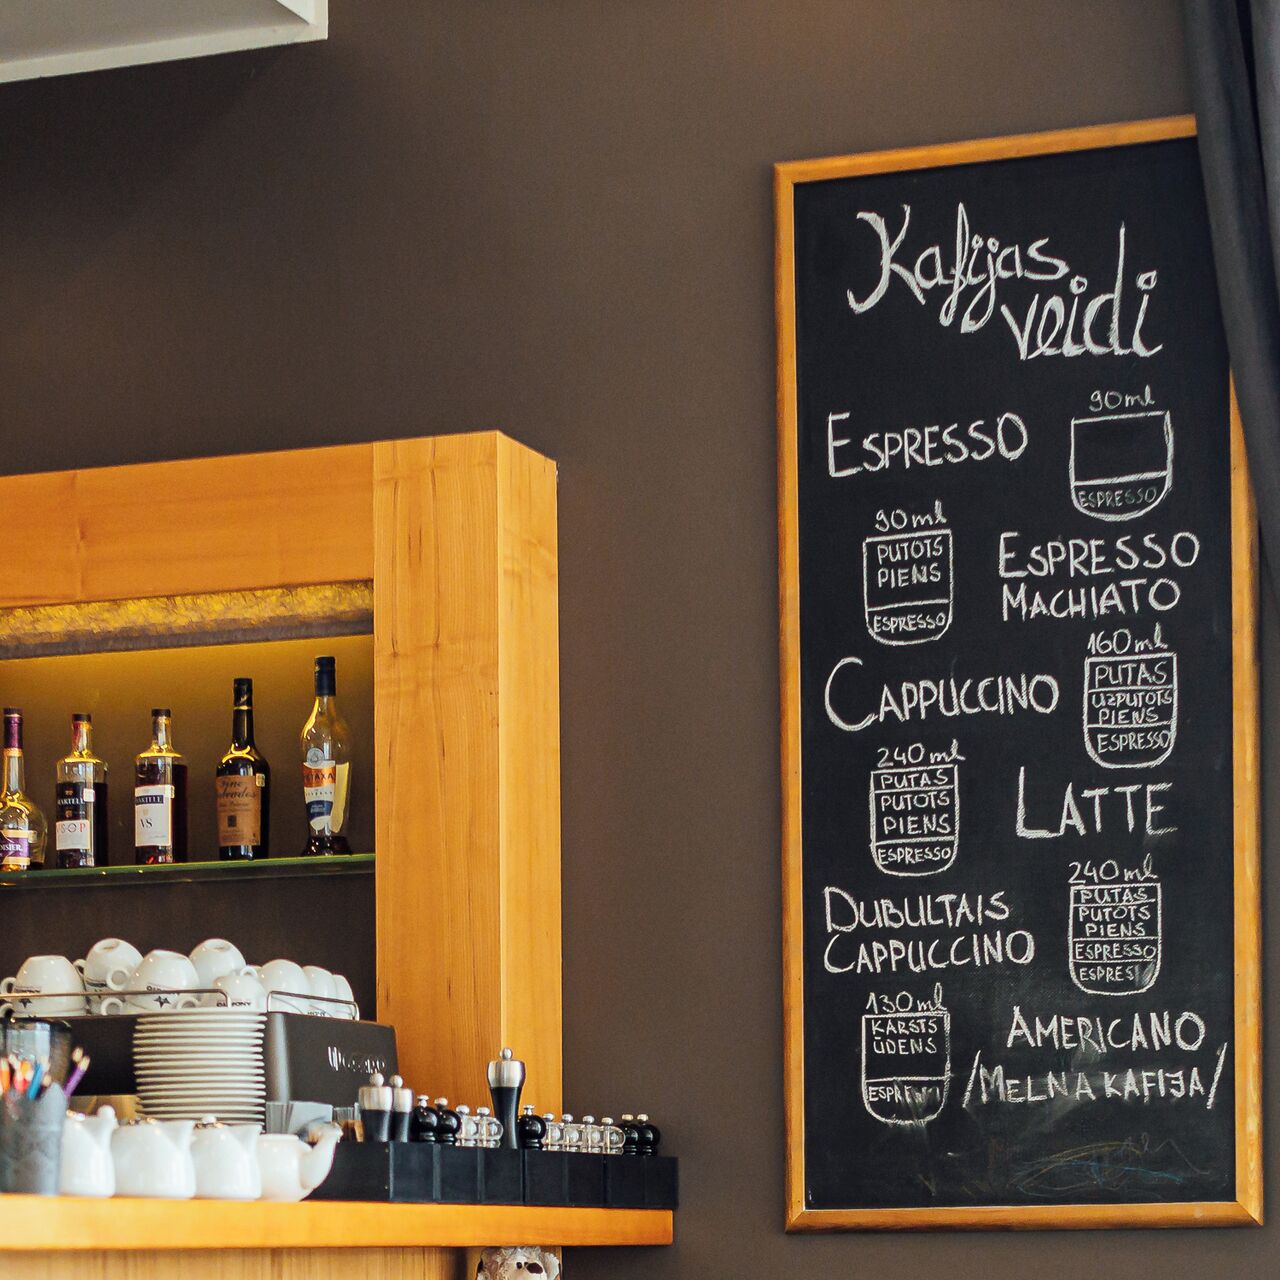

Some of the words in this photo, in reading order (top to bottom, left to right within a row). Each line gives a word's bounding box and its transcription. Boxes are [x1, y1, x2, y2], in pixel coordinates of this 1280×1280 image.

[846, 202, 1070, 334] Kafijas
[1000, 221, 1163, 361] veidi
[827, 411, 1028, 478] ESPRESSO
[1077, 486, 1158, 509] ESPRESSO
[877, 536, 943, 565] PUTOTS
[998, 531, 1201, 578] ESPRESSO
[877, 562, 941, 588] PIENS
[1002, 577, 1182, 622] MACHIATO
[873, 612, 946, 634] ESPRESSO
[1095, 661, 1168, 688] PUTAS
[824, 656, 1059, 731] CAPPUCCINO
[1091, 690, 1172, 708] UZPUTOTS
[1099, 706, 1159, 725] PIENS
[1097, 730, 1171, 753] ESPRESSO
[881, 769, 949, 789] PUTAS
[881, 791, 950, 811] PUTOTS
[1016, 766, 1178, 839] LATTE
[883, 814, 951, 834] PIENS
[878, 847, 952, 864] ESPRESSO
[1080, 888, 1148, 903] PUTAS
[824, 886, 1010, 932] DUBULTAIS
[1079, 905, 1151, 921] PUTOTS
[1085, 922, 1146, 936] PIENS
[824, 930, 1035, 973] CAPPUCCINO
[1075, 943, 1157, 960] ESPRESSO
[1079, 964, 1152, 983] ESPRES
[872, 1018, 938, 1035] KARSTS
[1007, 1005, 1205, 1053] AMERICANO
[873, 1036, 937, 1054] ŪDENS
